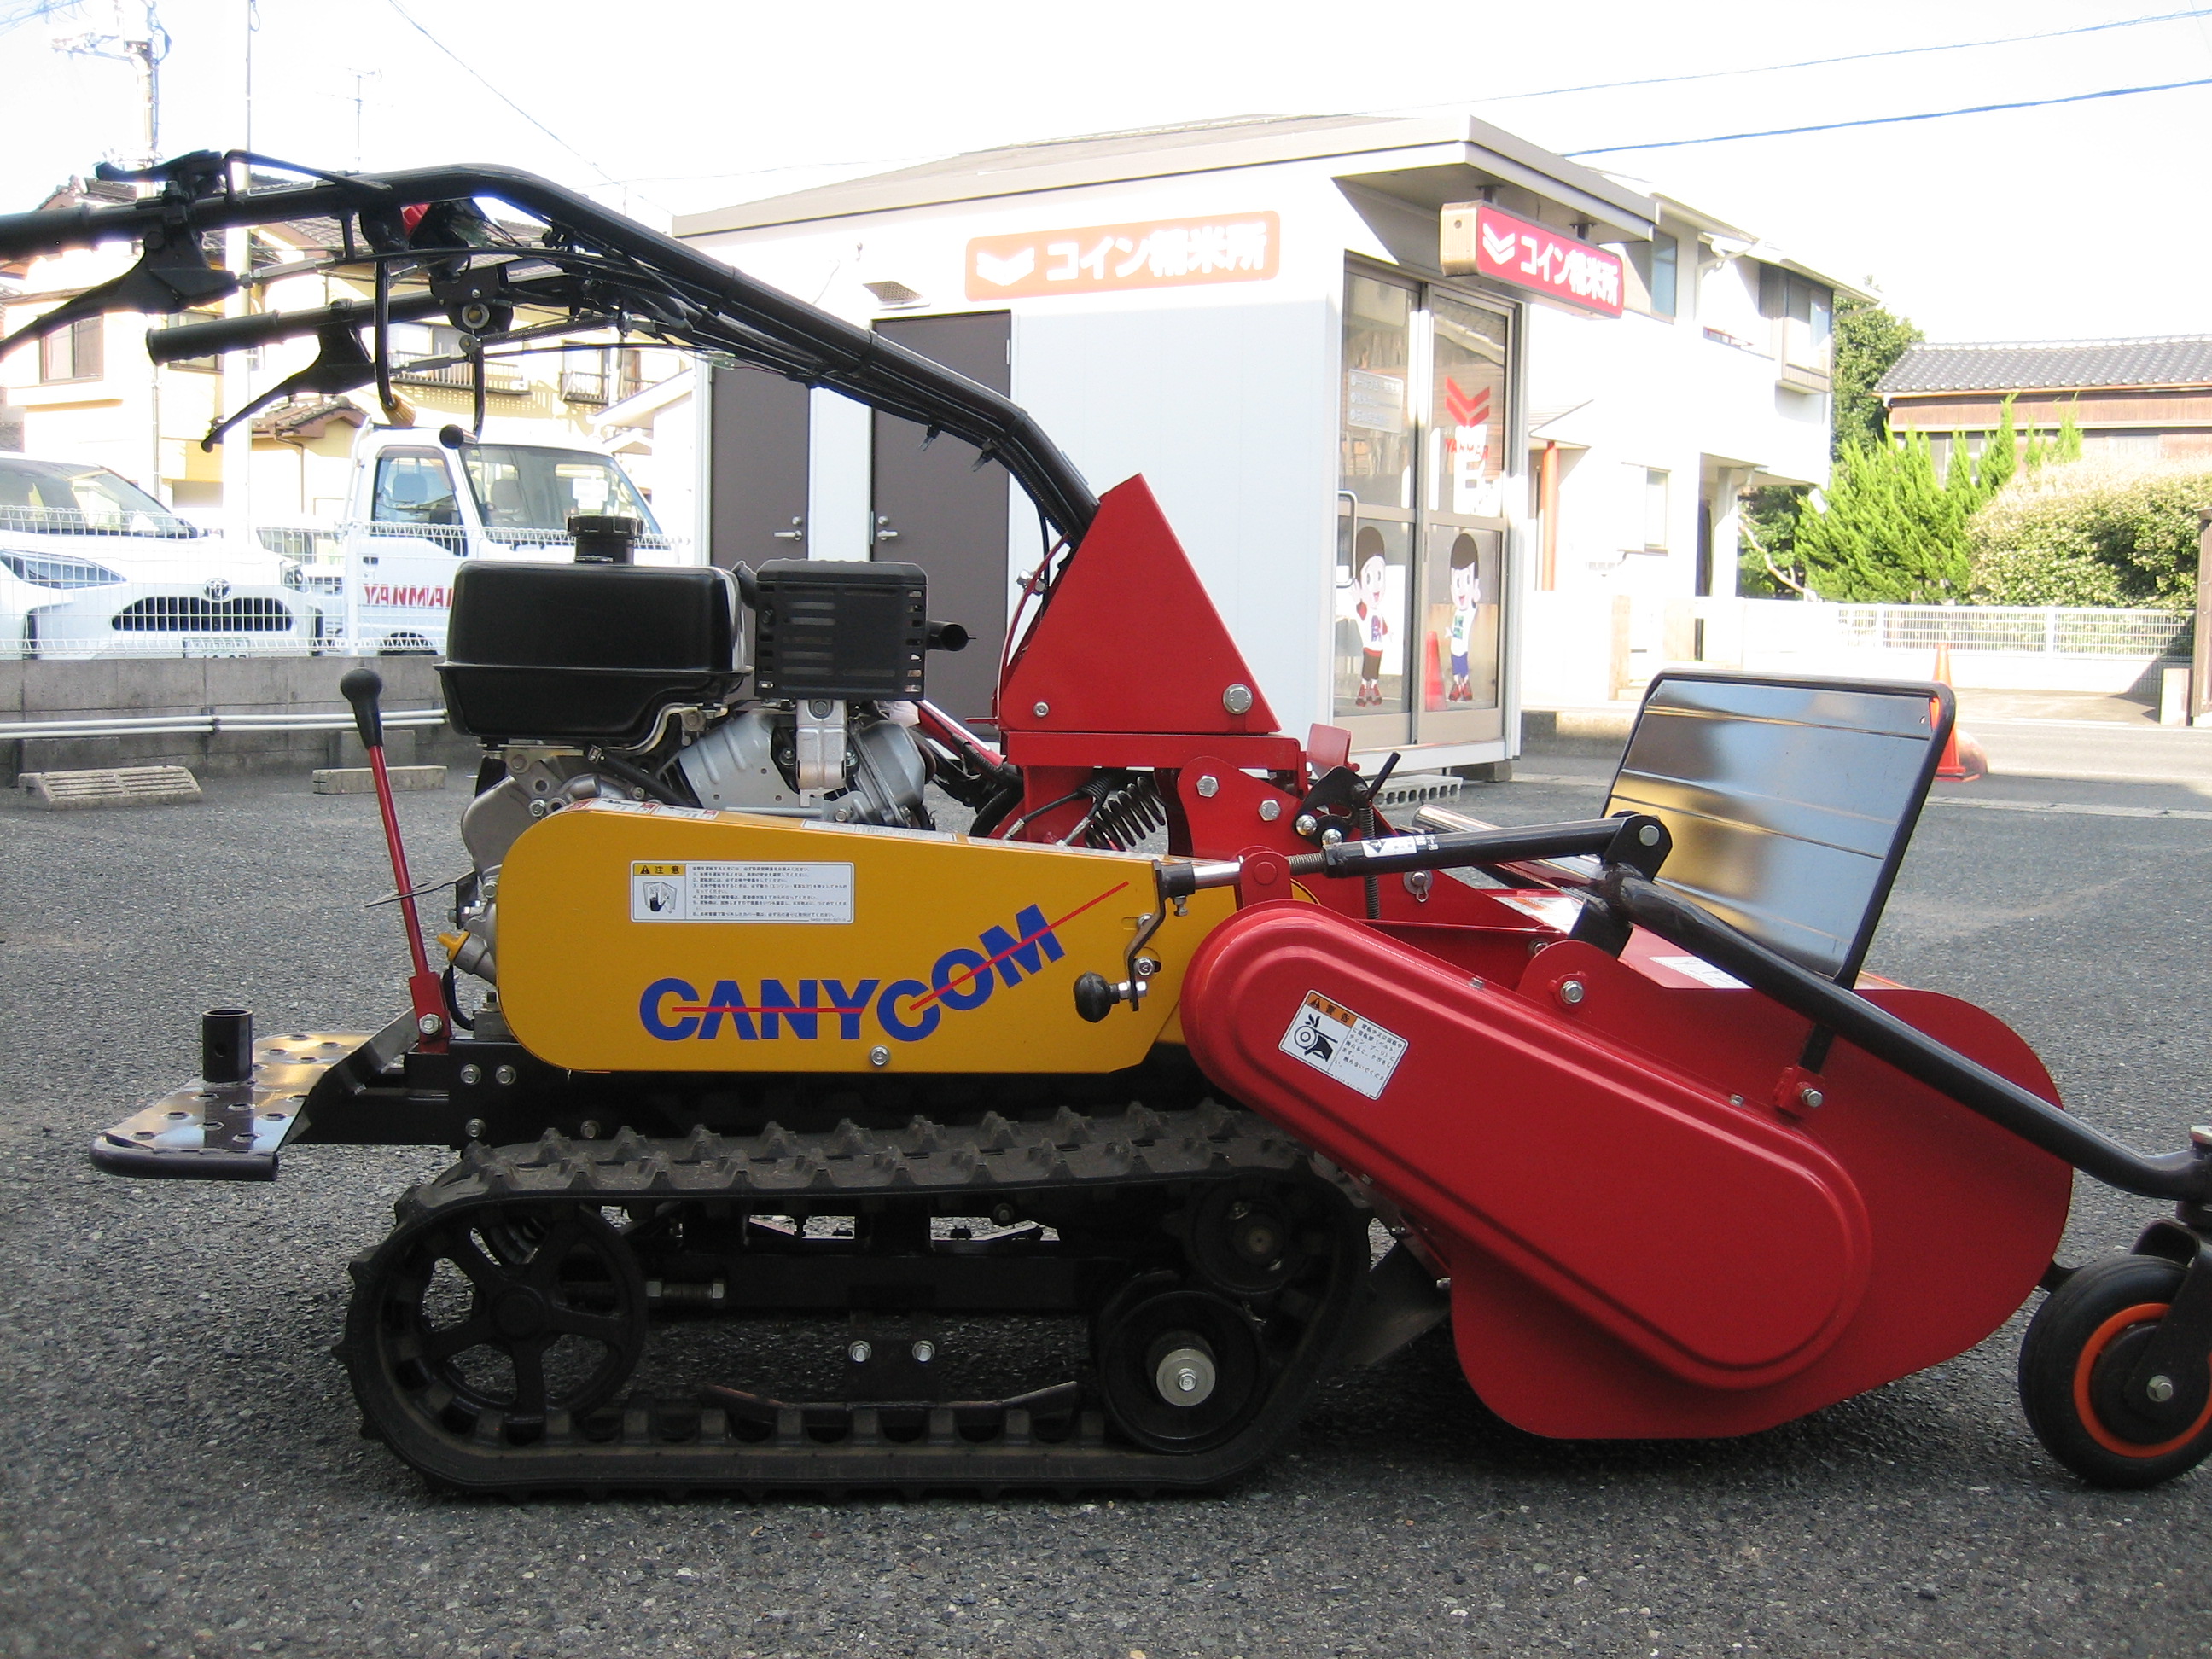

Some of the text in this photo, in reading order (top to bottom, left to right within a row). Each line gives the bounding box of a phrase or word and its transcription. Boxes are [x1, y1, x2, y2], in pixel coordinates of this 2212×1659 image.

[1045, 222, 1268, 281] コイン精米所
[1520, 235, 1619, 306] コイン精米所
[639, 904, 1065, 1041] CANYCOM
